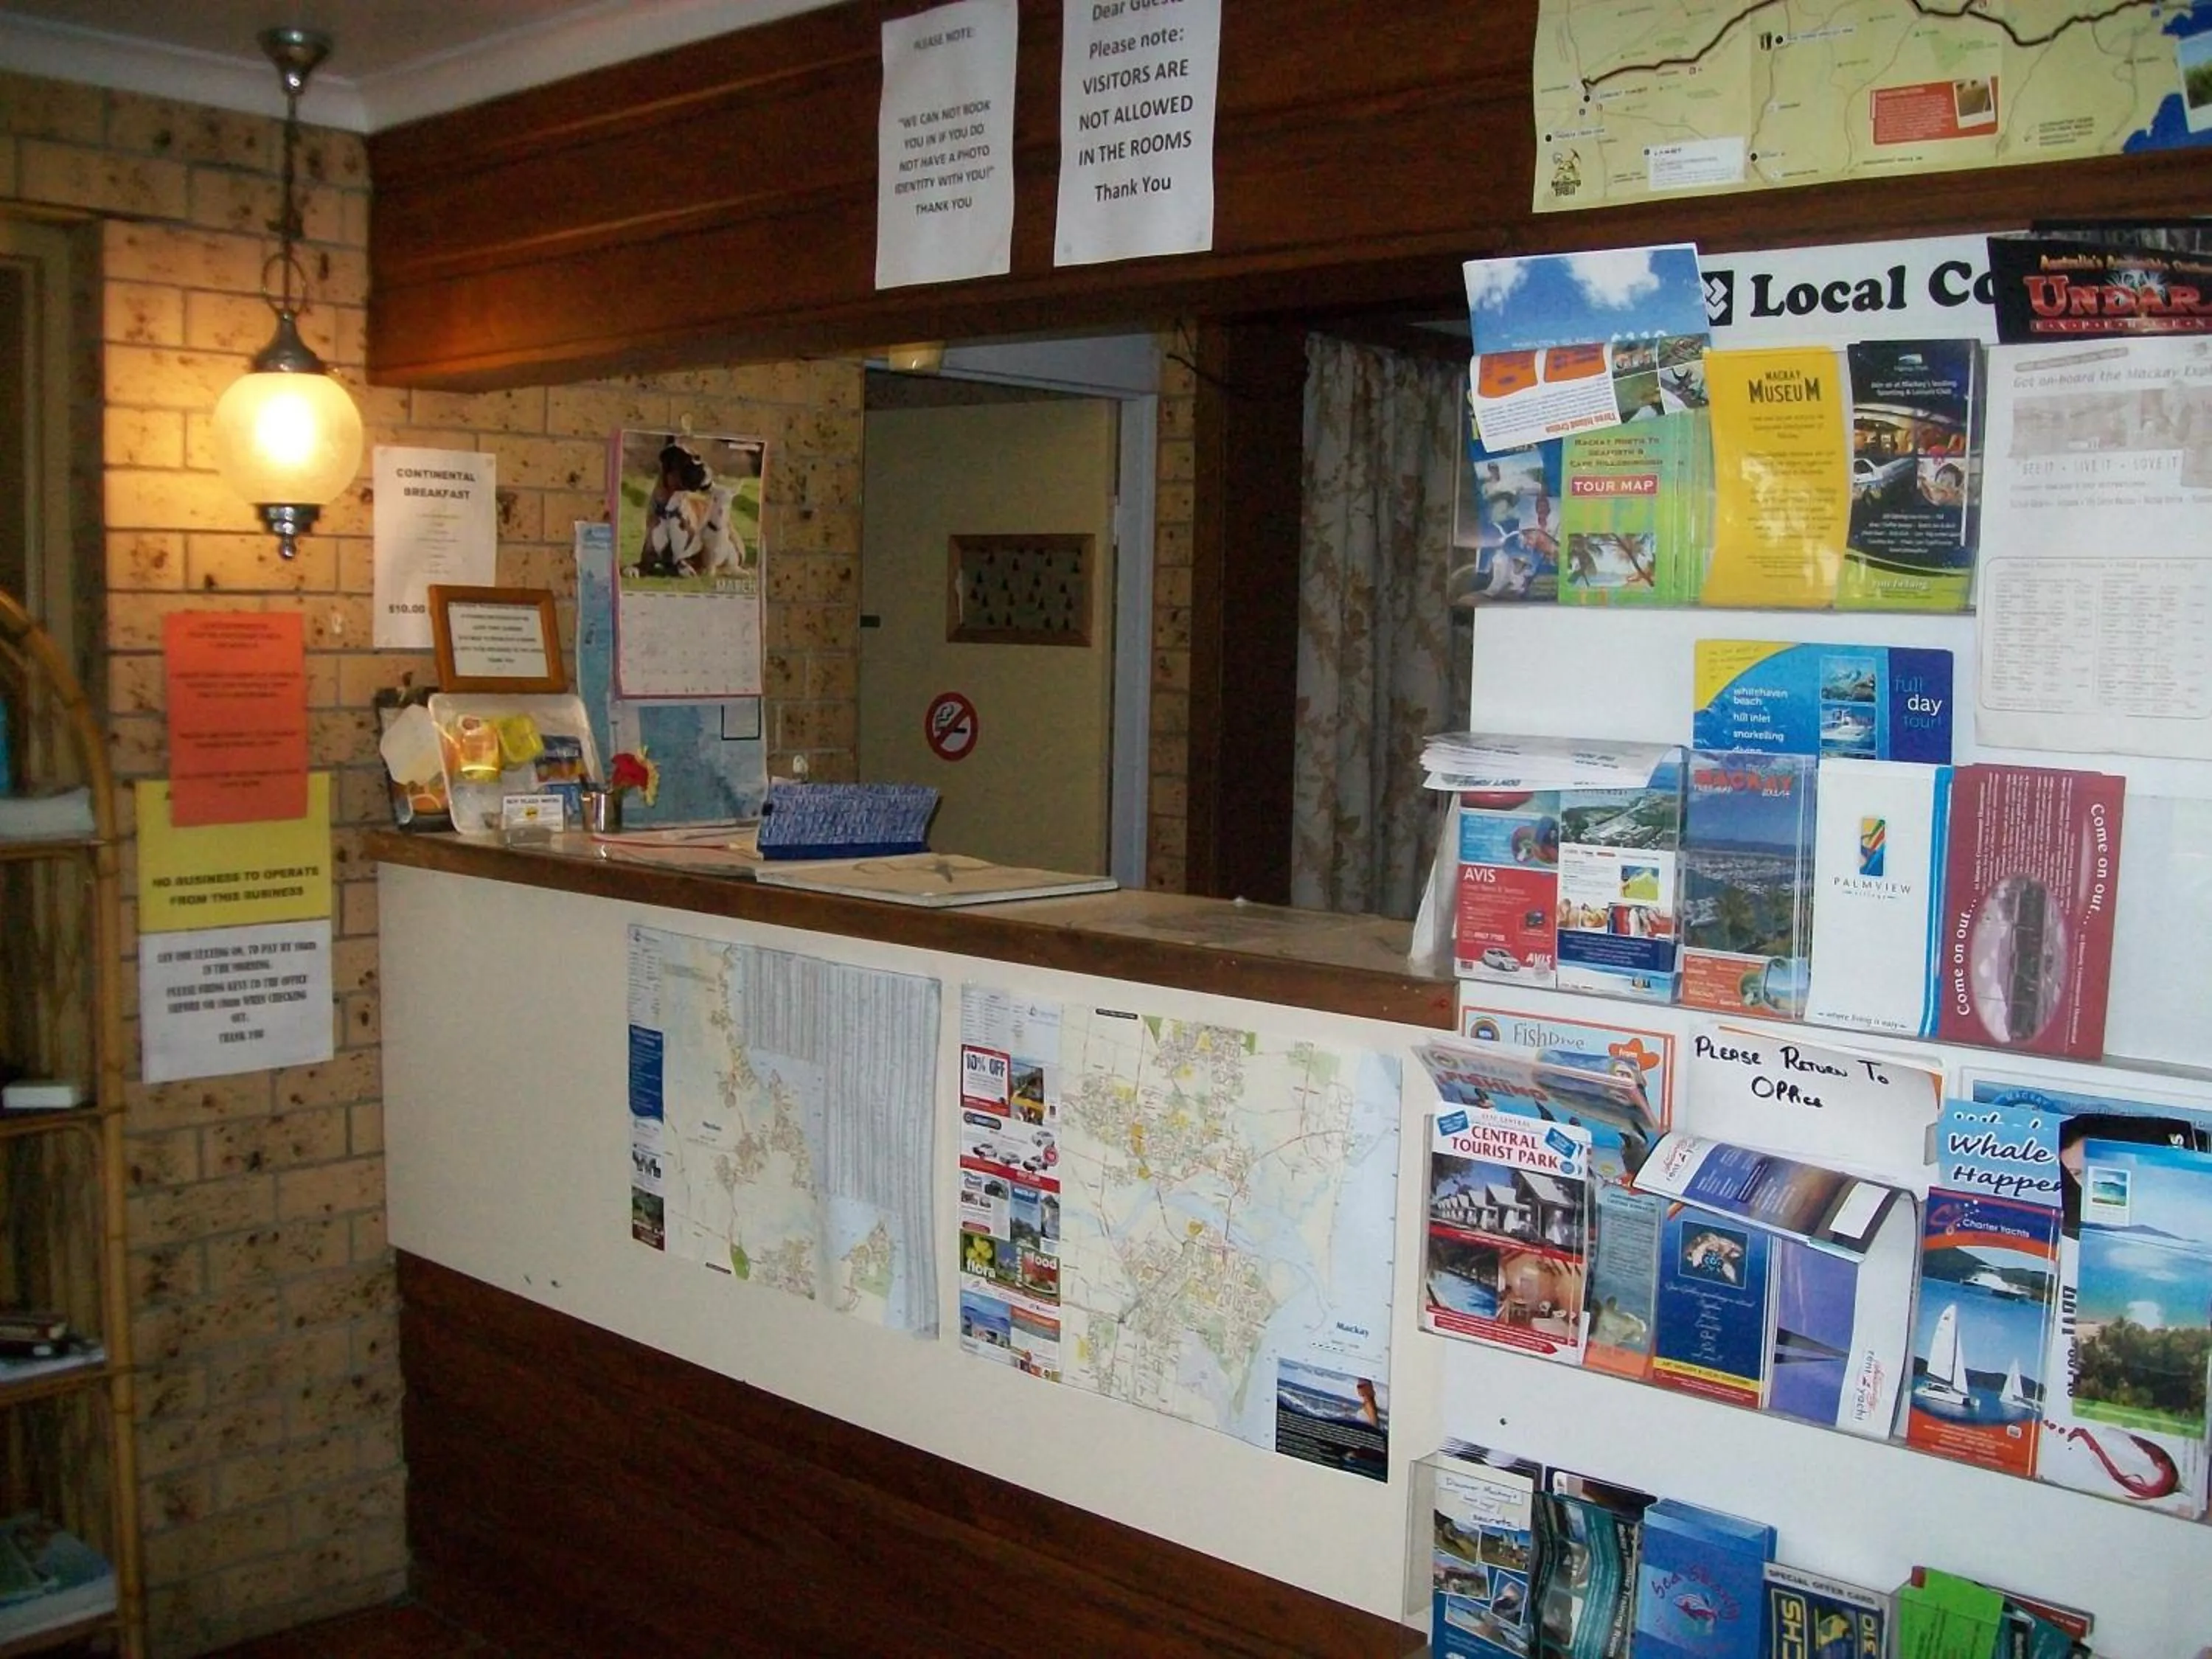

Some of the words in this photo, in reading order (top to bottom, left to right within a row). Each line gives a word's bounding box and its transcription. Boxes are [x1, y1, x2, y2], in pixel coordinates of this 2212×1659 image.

[1092, 1, 1126, 21] Dear
[1089, 36, 1136, 59] Please
[1141, 27, 1185, 47] note:
[1082, 65, 1151, 95] VISITORS
[1155, 58, 1189, 81] ARE
[919, 111, 939, 125] CAN
[942, 105, 961, 120] NOT
[962, 100, 991, 116] BOOK
[1079, 109, 1110, 131] NOT
[1114, 94, 1193, 124] ALLOWED
[904, 136, 924, 150] YOU
[948, 128, 968, 141] YOU
[970, 122, 985, 136] DO
[1079, 147, 1095, 166] IN
[1098, 142, 1126, 163] THE
[1130, 130, 1192, 157] ROOMS
[899, 159, 919, 173] NOT
[920, 153, 947, 167] HAVE
[956, 145, 990, 161] PHOTO
[894, 177, 936, 195] IDENTITY
[937, 172, 964, 187] WITH
[1095, 178, 1138, 202] Thank
[1143, 176, 1172, 193] You
[915, 200, 949, 216] THANK
[951, 196, 973, 210] YOU
[1750, 264, 1908, 319] Local
[2023, 274, 2212, 316] UNDAR
[1747, 377, 1822, 404] MUSEUM
[395, 467, 476, 483] CONTINENTAL
[1573, 481, 1616, 493] TOUR
[1621, 479, 1655, 492] MAP
[403, 487, 470, 501] BREAKFAST
[1733, 695, 1763, 706] beach
[1907, 694, 1943, 716] day
[2091, 803, 2109, 852] Come
[152, 877, 171, 888] NO
[175, 872, 240, 886] BUSINESS
[244, 871, 260, 882] TO
[263, 866, 320, 879] OPERATE
[1463, 866, 1496, 883] AVIS
[2097, 857, 2108, 879] on
[169, 894, 207, 906] FROM
[212, 891, 240, 903] THIS
[243, 886, 305, 901] BUSINESS
[1833, 877, 1911, 894] PALMVIEW
[1525, 952, 1552, 964] AVIS
[1954, 943, 1964, 964] on
[1955, 967, 1970, 1015] Come
[966, 1053, 987, 1073] 10%
[989, 1058, 1006, 1078] OFF
[1471, 1125, 1539, 1150] CENTRAL
[1949, 1133, 2054, 1164] Whale
[1452, 1136, 1513, 1161] TOURIST
[1518, 1149, 1559, 1169] PARK
[1961, 1218, 1998, 1232] Charter
[2000, 1223, 2031, 1239] Yachts
[966, 1257, 996, 1279] flora
[1336, 1320, 1370, 1336] Mackay
[1767, 1568, 1809, 1587] SPECIAL
[1812, 1580, 1844, 1596] OFFER
